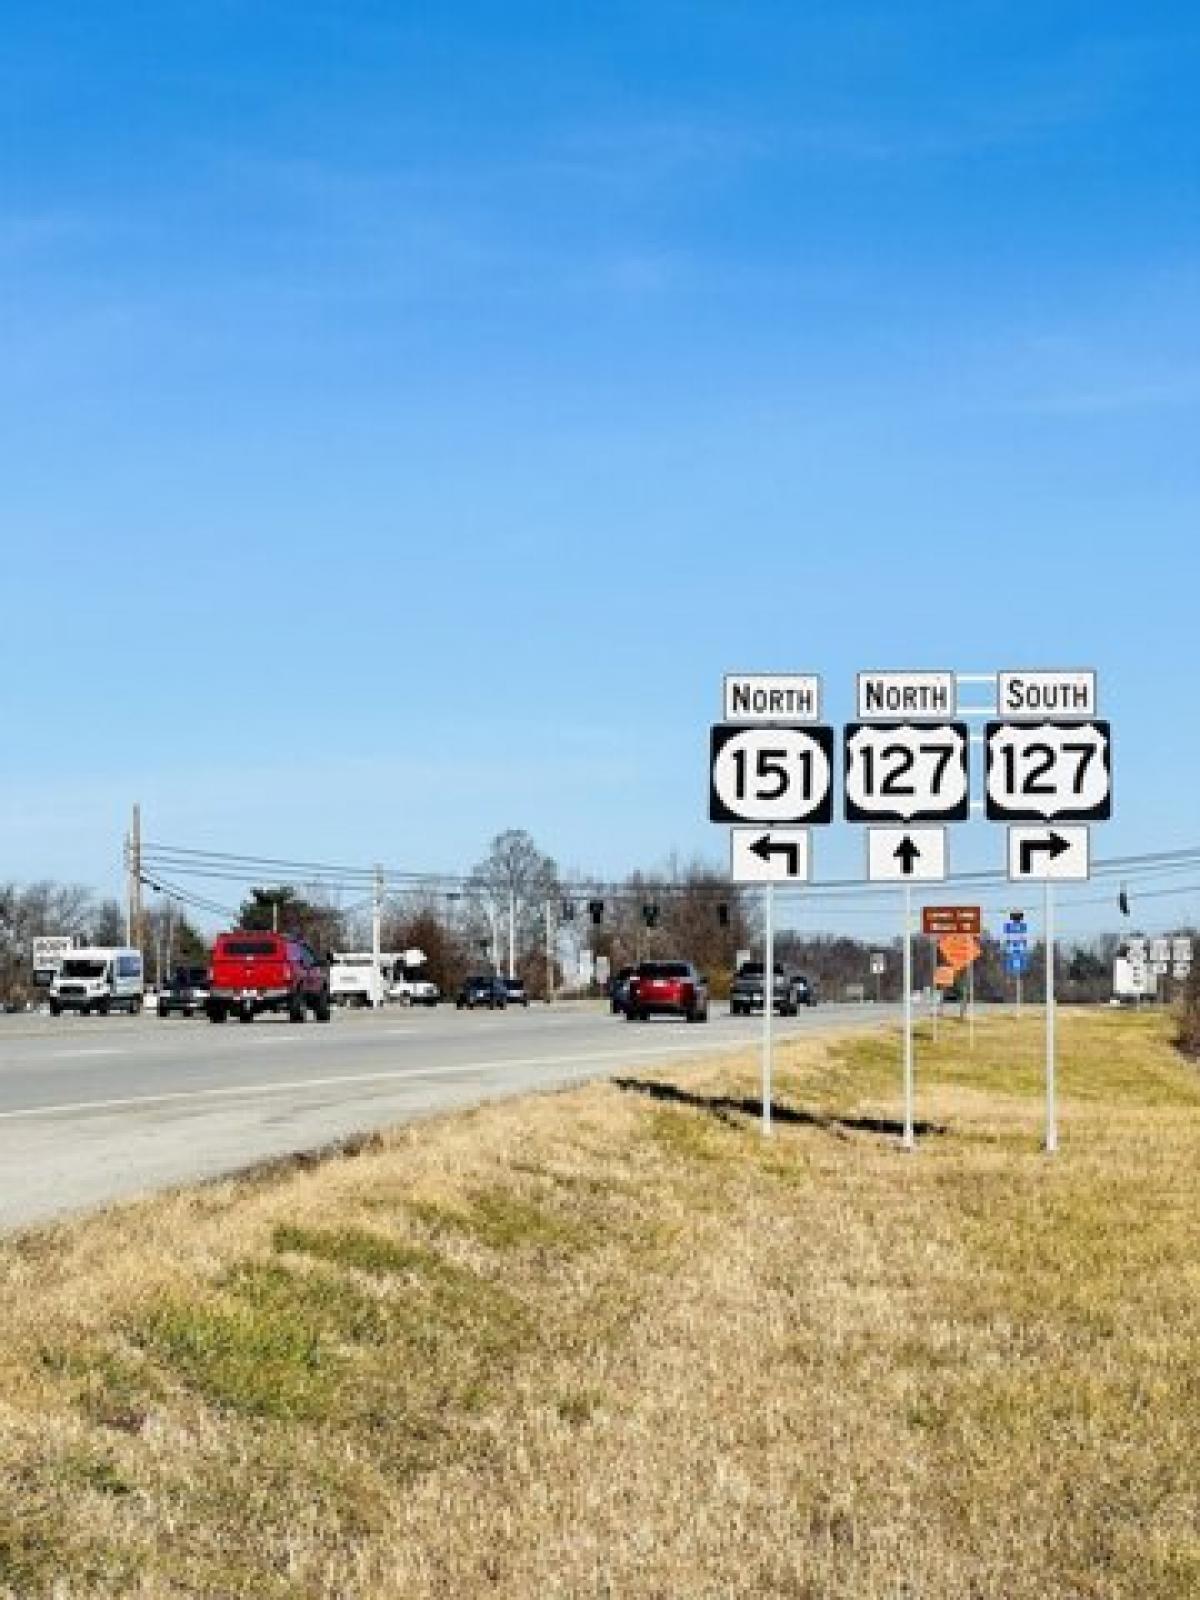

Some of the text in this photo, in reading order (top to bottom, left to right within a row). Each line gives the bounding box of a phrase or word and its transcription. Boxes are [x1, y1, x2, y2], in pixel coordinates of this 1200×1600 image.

[732, 682, 813, 713] NORTH
[865, 680, 947, 709] NORTH
[1006, 678, 1089, 709] SOUTH
[732, 749, 813, 801] 151
[859, 743, 955, 797] 127
[1000, 742, 1097, 795] 127
